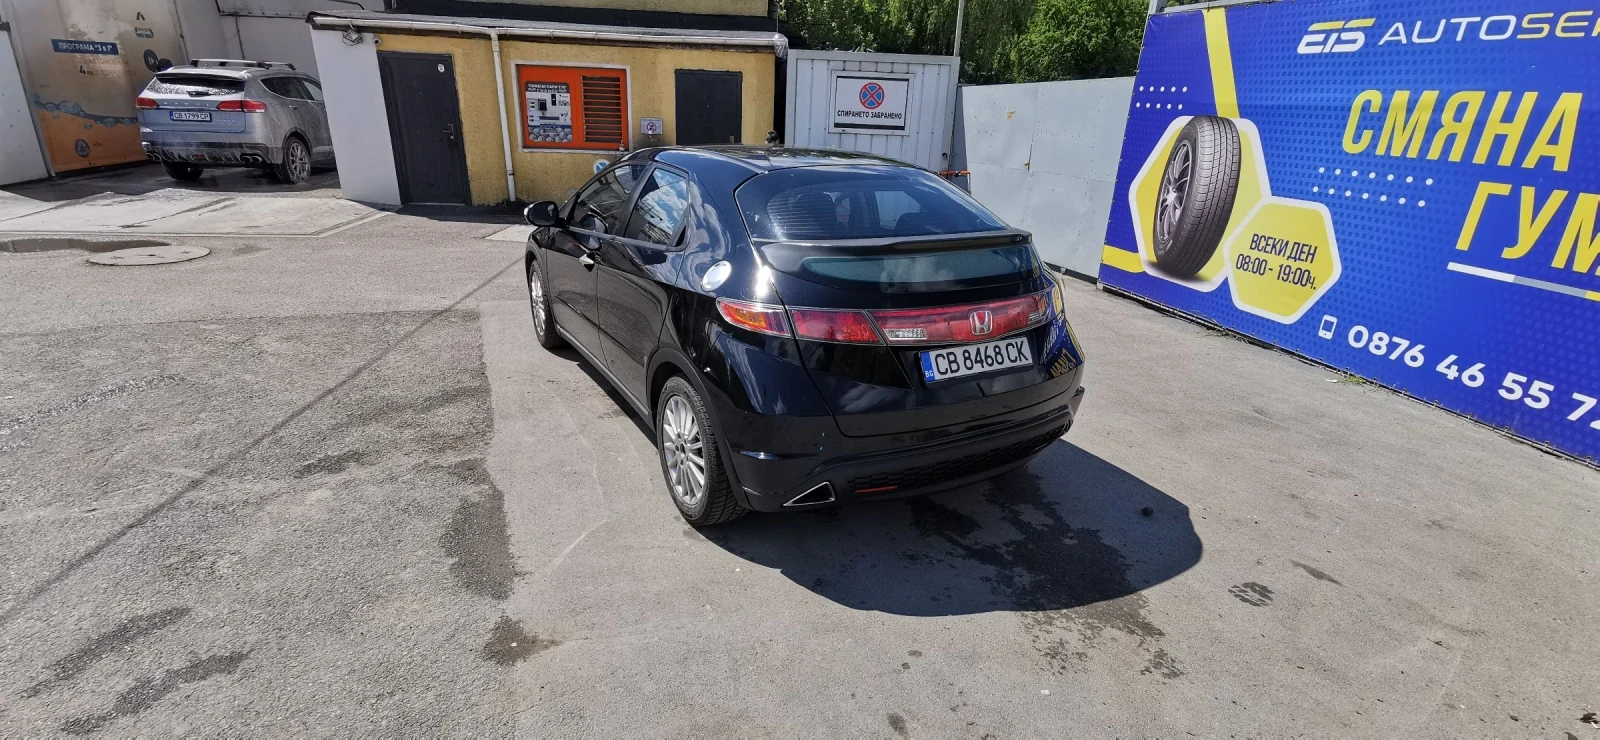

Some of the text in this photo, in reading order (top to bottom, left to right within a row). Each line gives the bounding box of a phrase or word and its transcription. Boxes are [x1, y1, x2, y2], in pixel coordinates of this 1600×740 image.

[1378, 10, 1600, 46] AUTOSE
[58, 42, 94, 51] ПРОГРАМА
[79, 65, 86, 75] 4
[185, 112, 199, 120] 1799
[837, 110, 902, 120] СПИРАНЕТО ЗАБРАНЕНО
[1342, 89, 1583, 172] СМЯНА
[1250, 233, 1317, 263] ВСЕКИ ДЕН
[1236, 253, 1267, 276] 08:00
[1277, 263, 1316, 290] 19:00ч.
[934, 352, 960, 376] CB
[963, 344, 1004, 371] 8468
[1007, 341, 1029, 366] CK
[925, 370, 934, 378] BG
[1348, 325, 1600, 430] 0876 46 55 7
